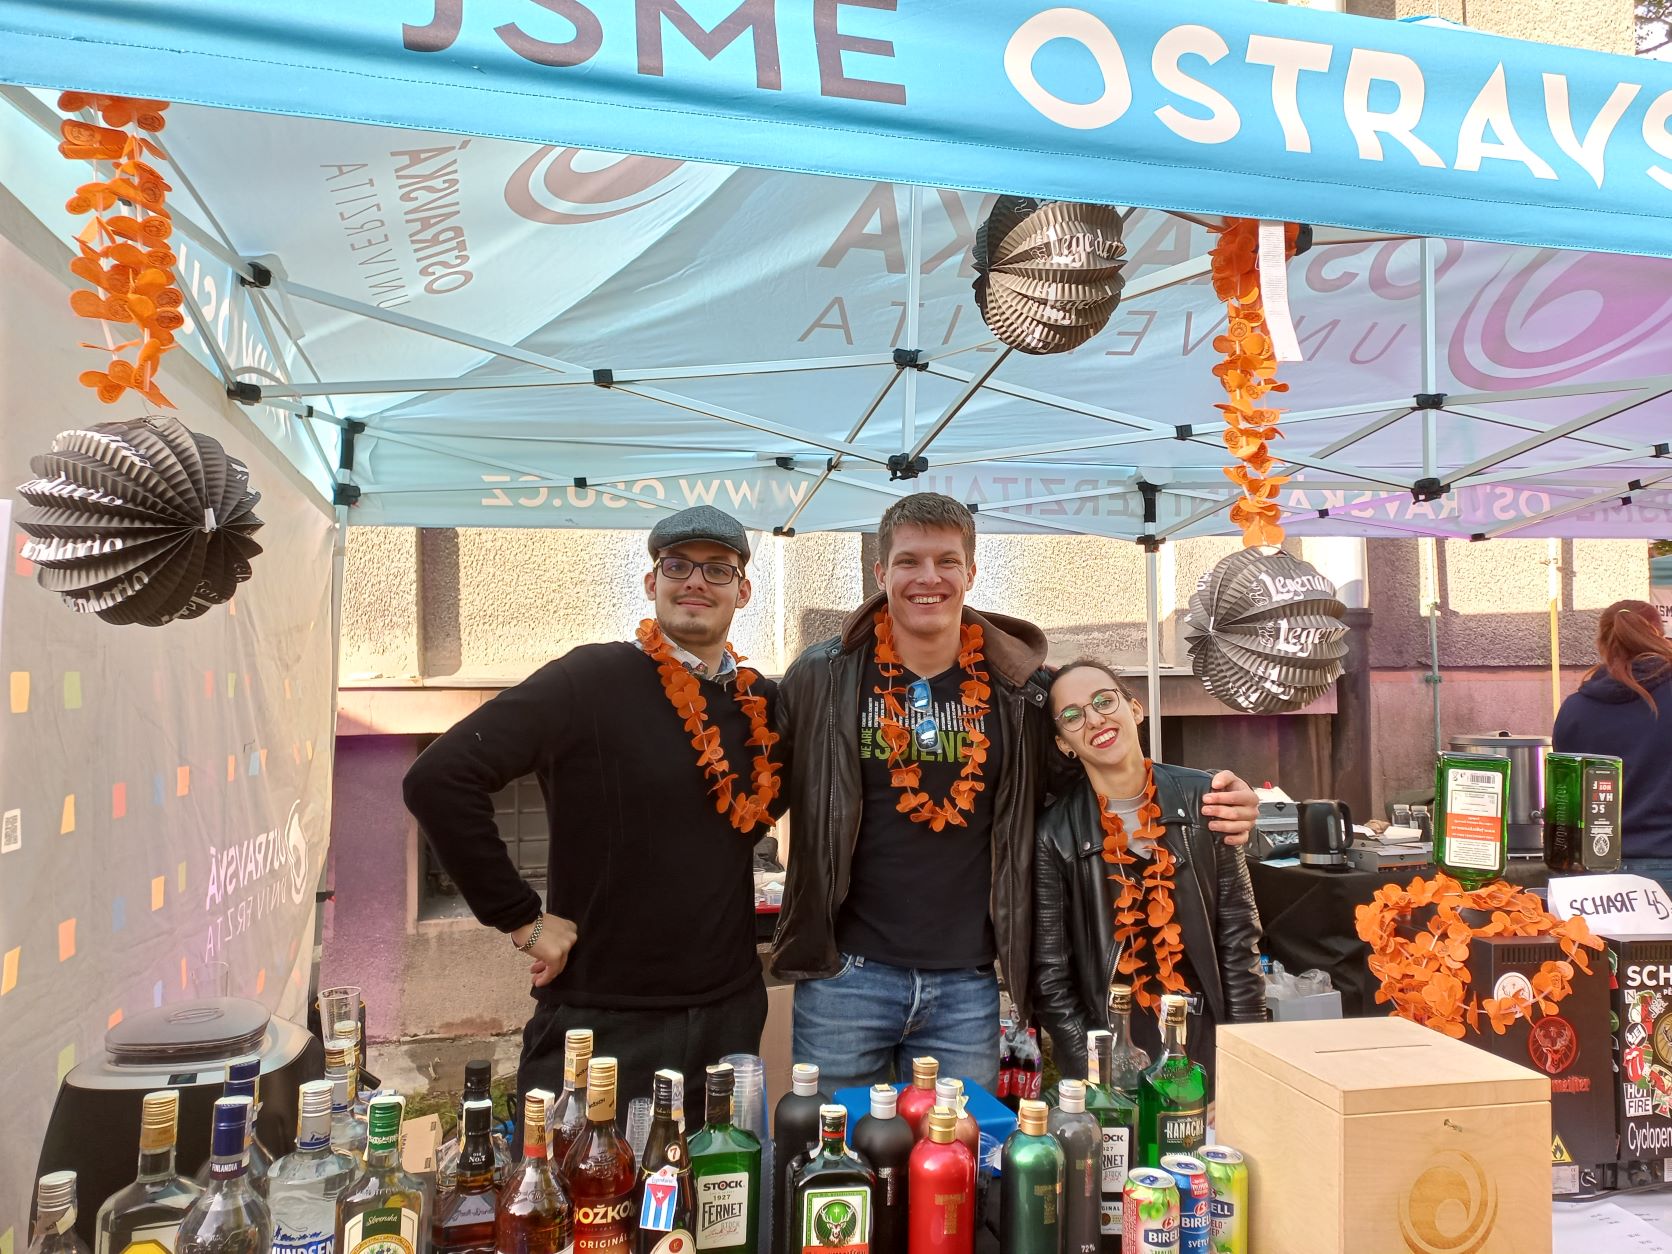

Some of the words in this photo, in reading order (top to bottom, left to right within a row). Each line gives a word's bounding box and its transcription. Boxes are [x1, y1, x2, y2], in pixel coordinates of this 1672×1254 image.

[1627, 1099, 1651, 1114] FIRE
[703, 1180, 743, 1191] STOCK
[702, 1201, 743, 1230] FERNET
[1081, 1244, 1096, 1253] 72%
